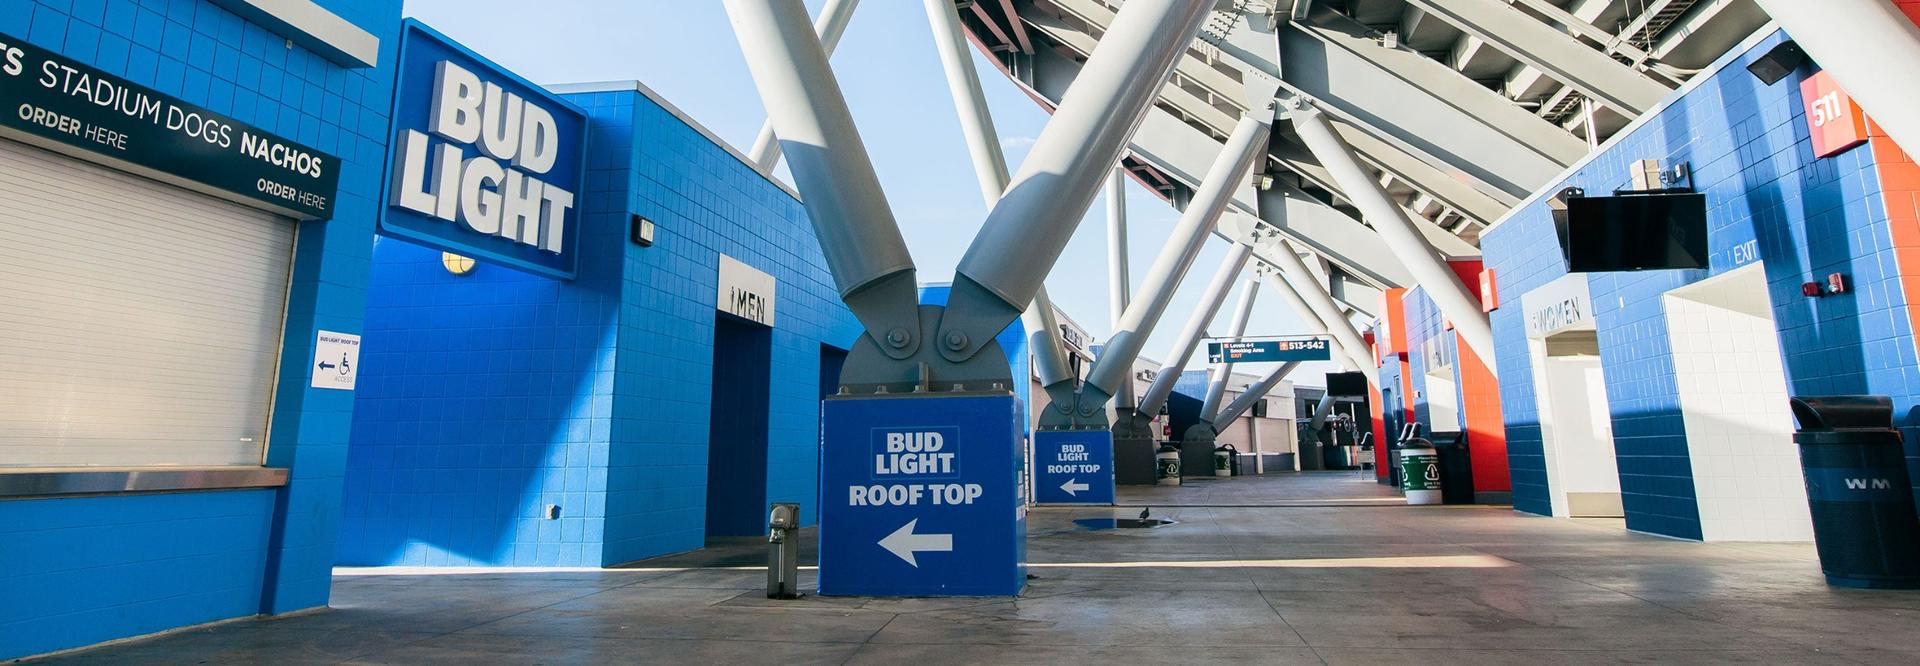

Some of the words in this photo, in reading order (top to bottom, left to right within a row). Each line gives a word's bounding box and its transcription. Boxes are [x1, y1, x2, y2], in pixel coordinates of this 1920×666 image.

[39, 60, 161, 125] STADIUM
[166, 104, 232, 148] DOGS
[240, 131, 322, 178] NACHOS
[431, 60, 559, 174] BUD
[1810, 91, 1842, 127] 511
[18, 103, 82, 136] ORDER
[84, 123, 129, 150] HERE
[257, 178, 297, 201] ORDER
[298, 190, 326, 210] HERE
[391, 129, 574, 255] LIGHT
[1733, 239, 1757, 265] EXIT
[737, 287, 765, 324] MEN
[1537, 296, 1581, 332] WOMEN
[1289, 341, 1324, 350] 513-542
[887, 432, 944, 453] BUD
[1057, 452, 1089, 461] LIGHT
[1061, 444, 1085, 453] BUD
[876, 453, 955, 474] LIGHT
[1047, 464, 1078, 473] ROOF
[1078, 464, 1101, 473] TOP
[849, 484, 924, 506] ROOF
[928, 483, 983, 505] TOP
